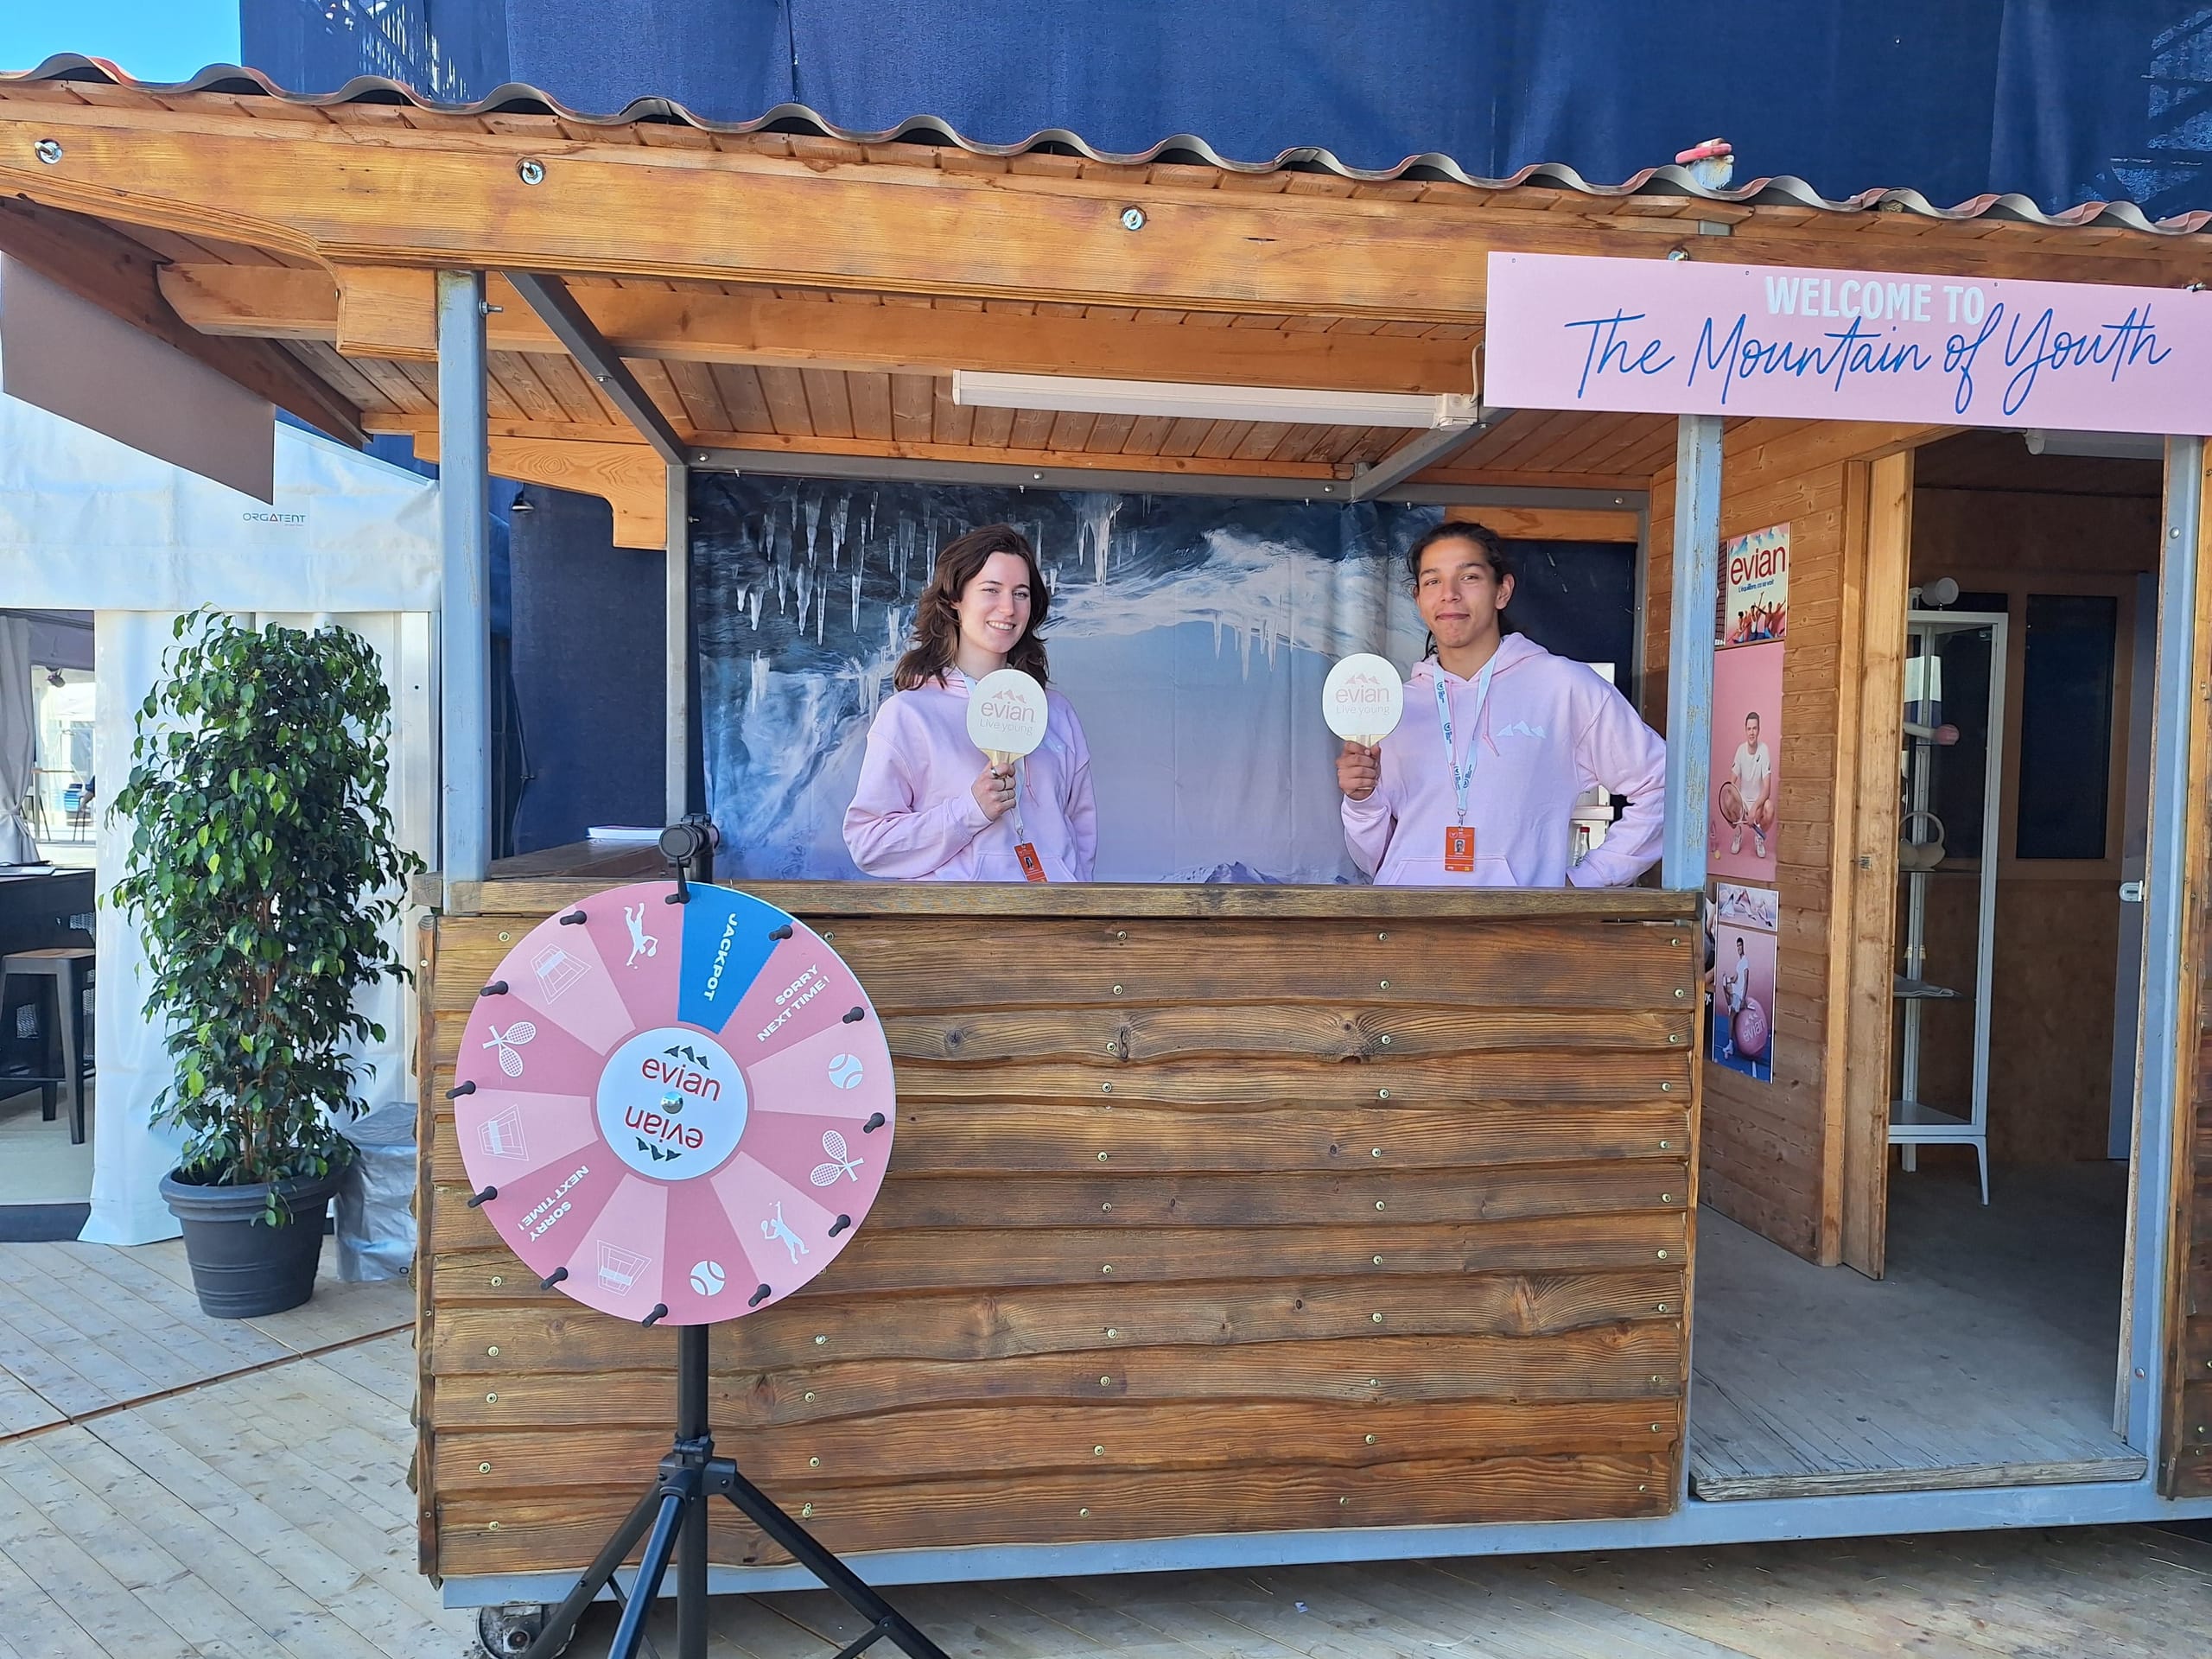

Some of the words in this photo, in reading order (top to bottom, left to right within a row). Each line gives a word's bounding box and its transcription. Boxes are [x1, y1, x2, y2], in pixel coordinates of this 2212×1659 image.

[1764, 276, 1932, 322] WELCOME
[1942, 285, 1986, 325] TO
[1564, 308, 1676, 399] The
[1688, 313, 1933, 405] Mountain
[1943, 302, 2005, 415] of
[2002, 302, 2172, 416] Youth
[1730, 546, 1787, 586] evian
[981, 701, 1035, 723] evian
[1336, 684, 1390, 704] evian
[703, 912, 739, 1002] JACKPOT
[774, 963, 819, 1006] SORRY
[756, 1007, 793, 1043] NEXT
[1742, 1018, 1765, 1042] evian
[641, 1058, 721, 1102] evian
[625, 1105, 705, 1149] evian
[554, 1164, 590, 1199] NEXT
[529, 1201, 573, 1243] SORRY
